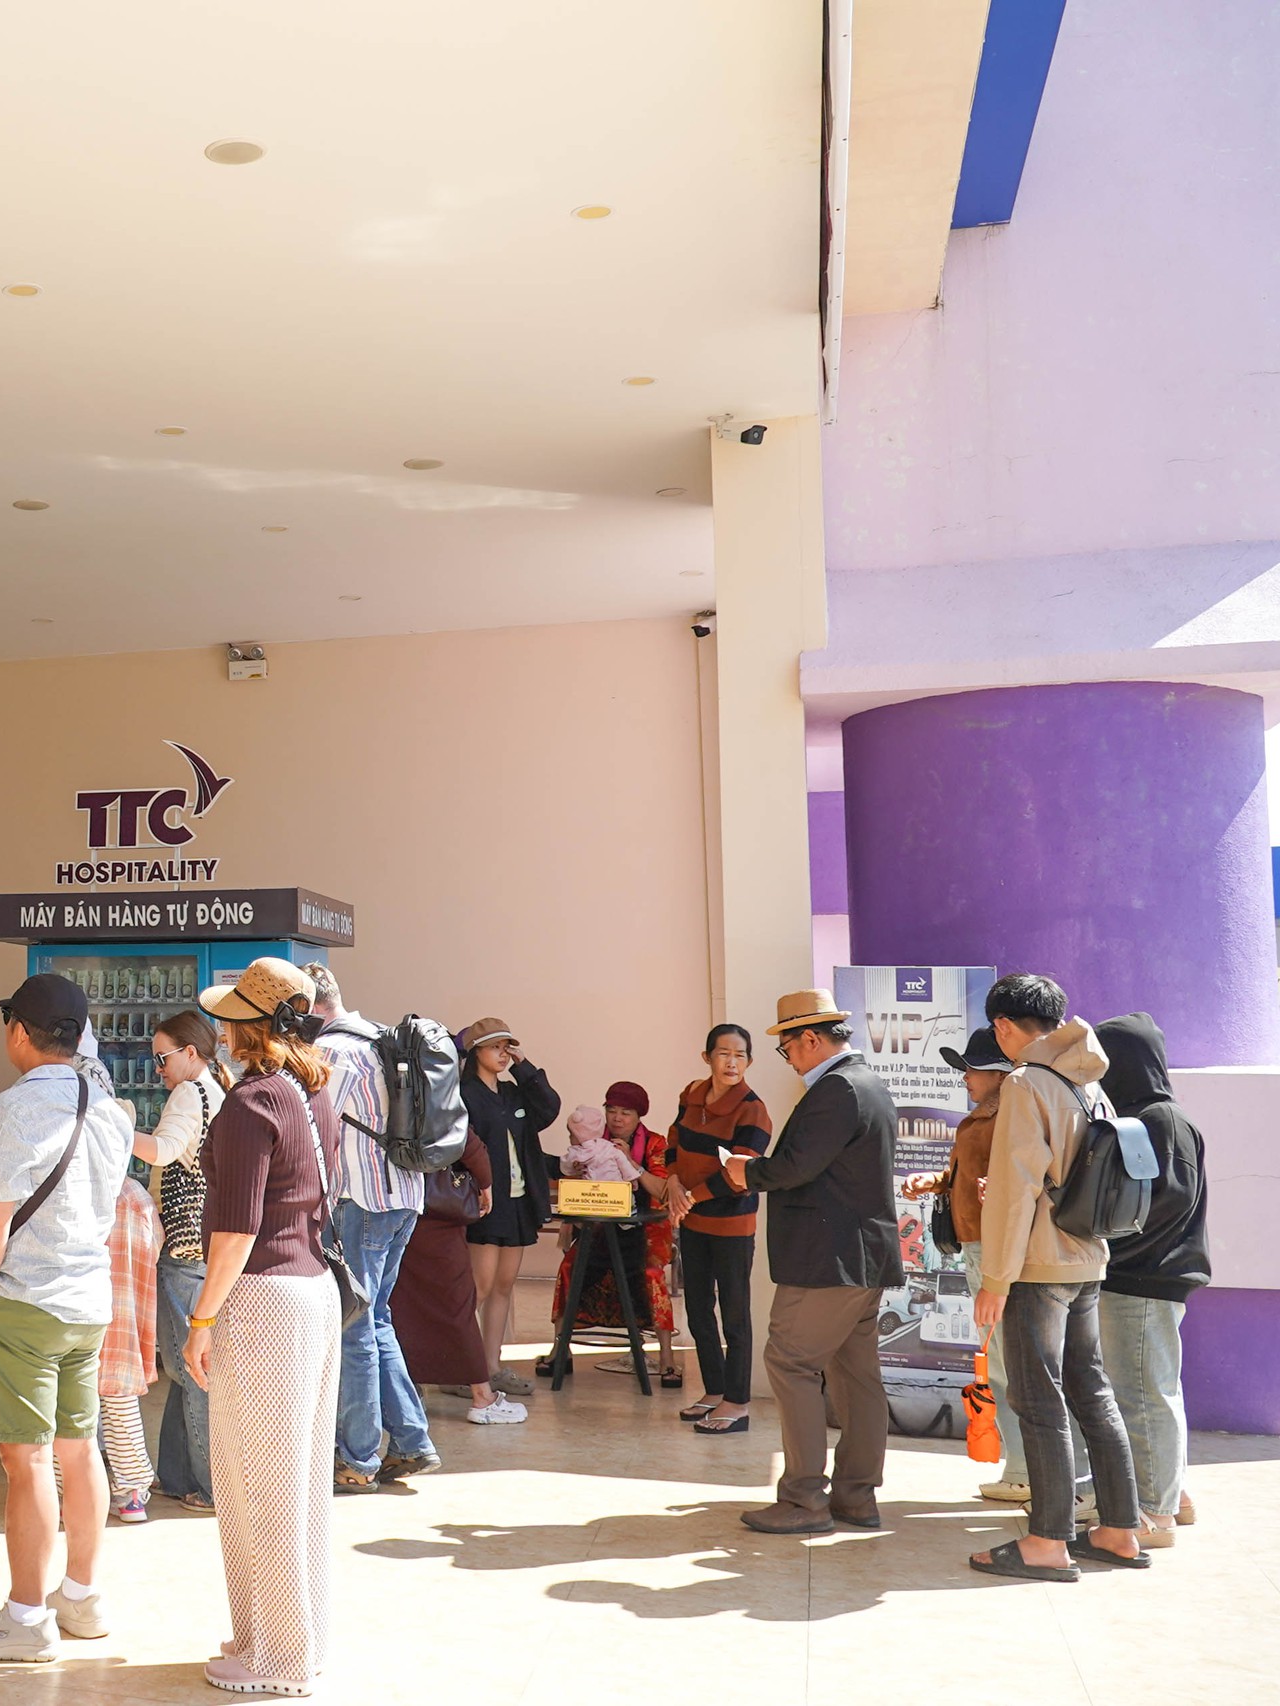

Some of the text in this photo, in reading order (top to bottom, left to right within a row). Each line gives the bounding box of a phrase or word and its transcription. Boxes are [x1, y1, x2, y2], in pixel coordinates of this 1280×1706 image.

[76, 789, 197, 848] TTC
[55, 857, 220, 886] HOSPITALITY
[20, 897, 254, 931] MÁY BÁN HÀNG TỰ ĐỘNG
[905, 981, 923, 990] TTC
[866, 1012, 965, 1057] VIP Tour
